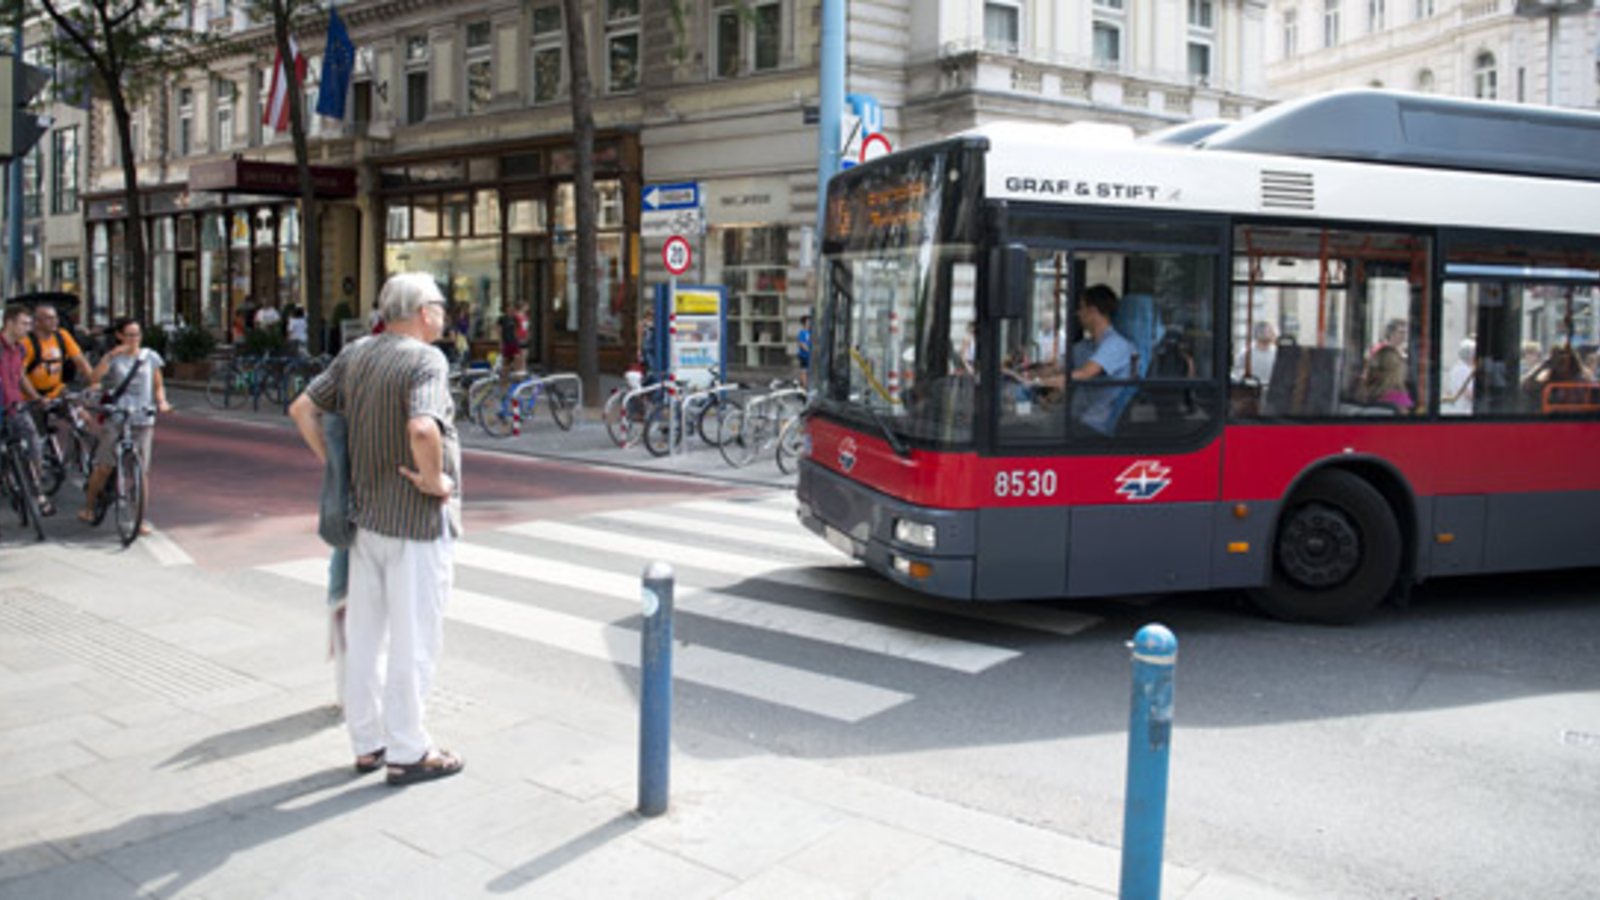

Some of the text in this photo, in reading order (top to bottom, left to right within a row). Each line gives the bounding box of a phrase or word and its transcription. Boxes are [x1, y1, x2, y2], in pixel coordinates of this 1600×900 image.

[864, 103, 882, 133] U
[1075, 182, 1090, 196] &
[1096, 183, 1158, 199] STIFT
[995, 469, 1057, 496] 8530
